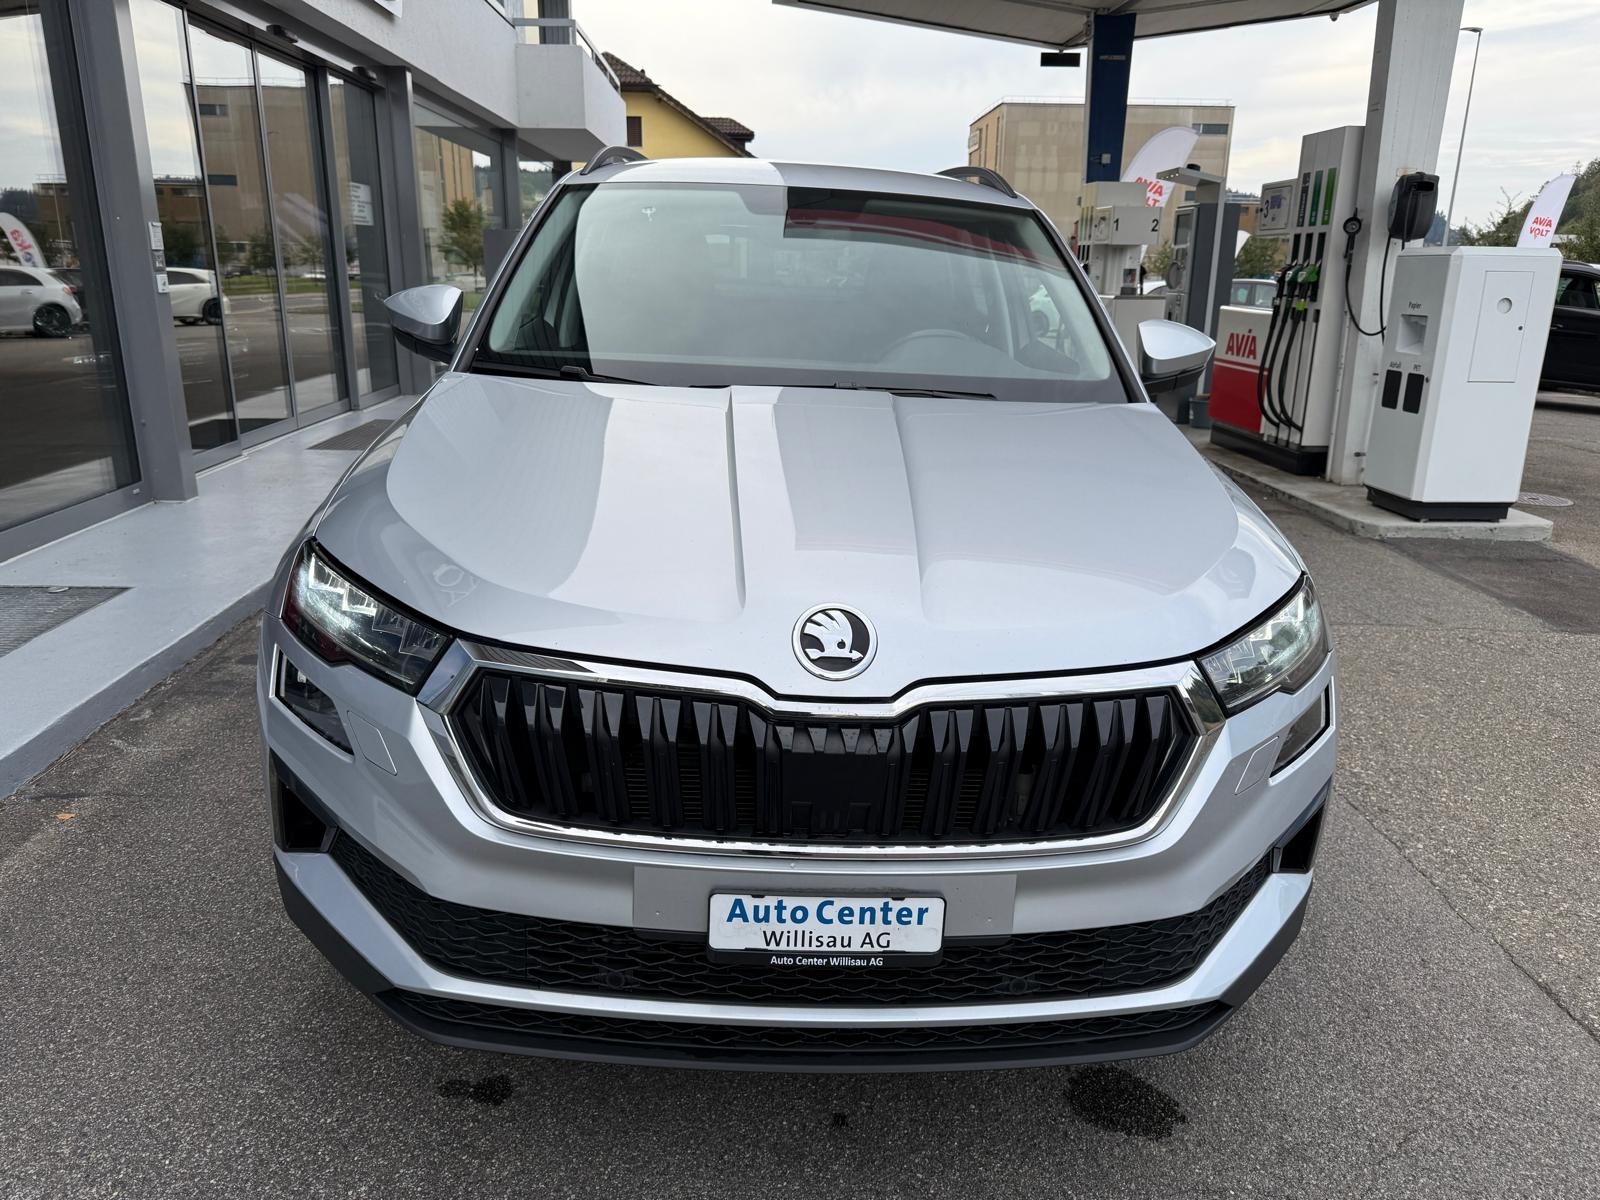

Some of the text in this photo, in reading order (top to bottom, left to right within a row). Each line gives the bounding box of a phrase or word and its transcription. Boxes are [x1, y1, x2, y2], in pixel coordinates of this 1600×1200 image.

[1263, 199, 1269, 218] 3
[1113, 218, 1119, 231] 1
[1151, 218, 1159, 232] 2
[1529, 227, 1550, 238] VOLT
[1408, 301, 1422, 311] Papier
[726, 898, 929, 926] Auto Center
[762, 930, 891, 949] Willisau AG
[770, 955, 884, 967] Auto Center Willisau AG
